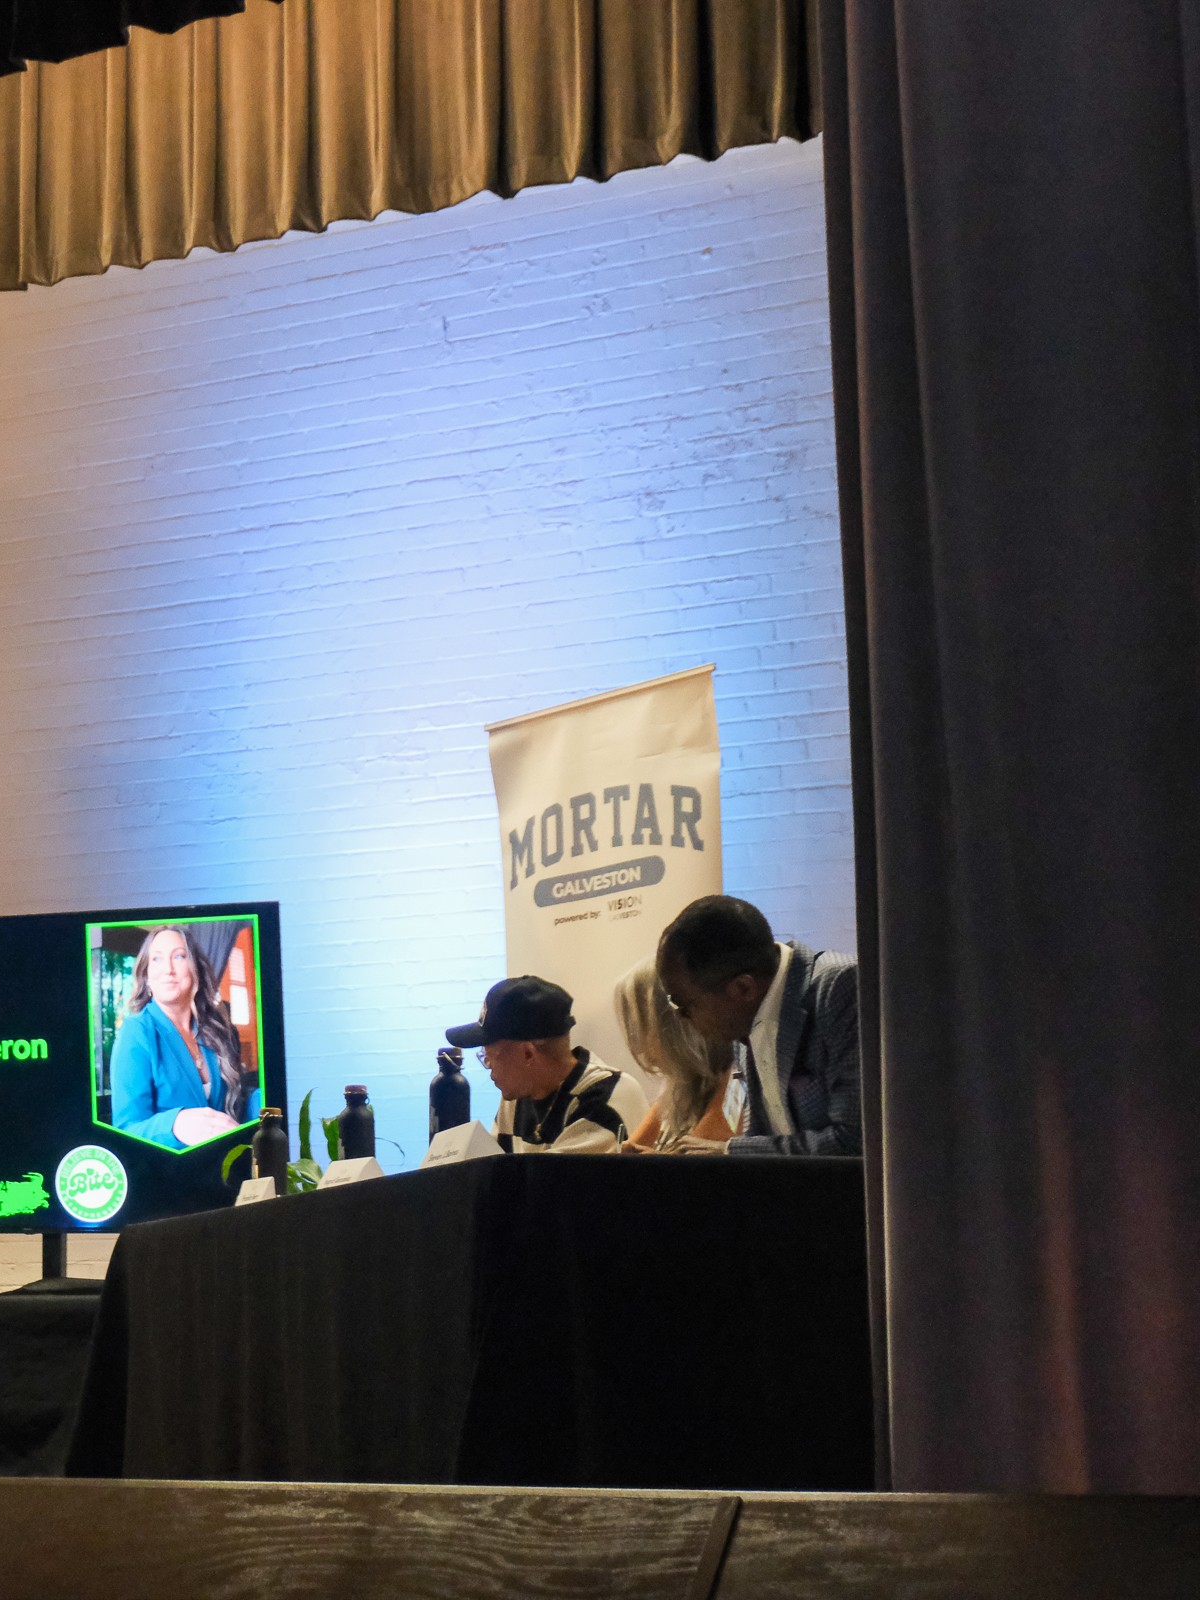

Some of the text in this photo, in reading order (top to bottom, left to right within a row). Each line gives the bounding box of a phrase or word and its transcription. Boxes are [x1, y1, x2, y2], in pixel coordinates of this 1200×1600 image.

[509, 783, 704, 891] MORTAR
[552, 866, 641, 898] GALVESTON
[608, 894, 642, 912] VISION
[68, 1168, 117, 1198] Bite
